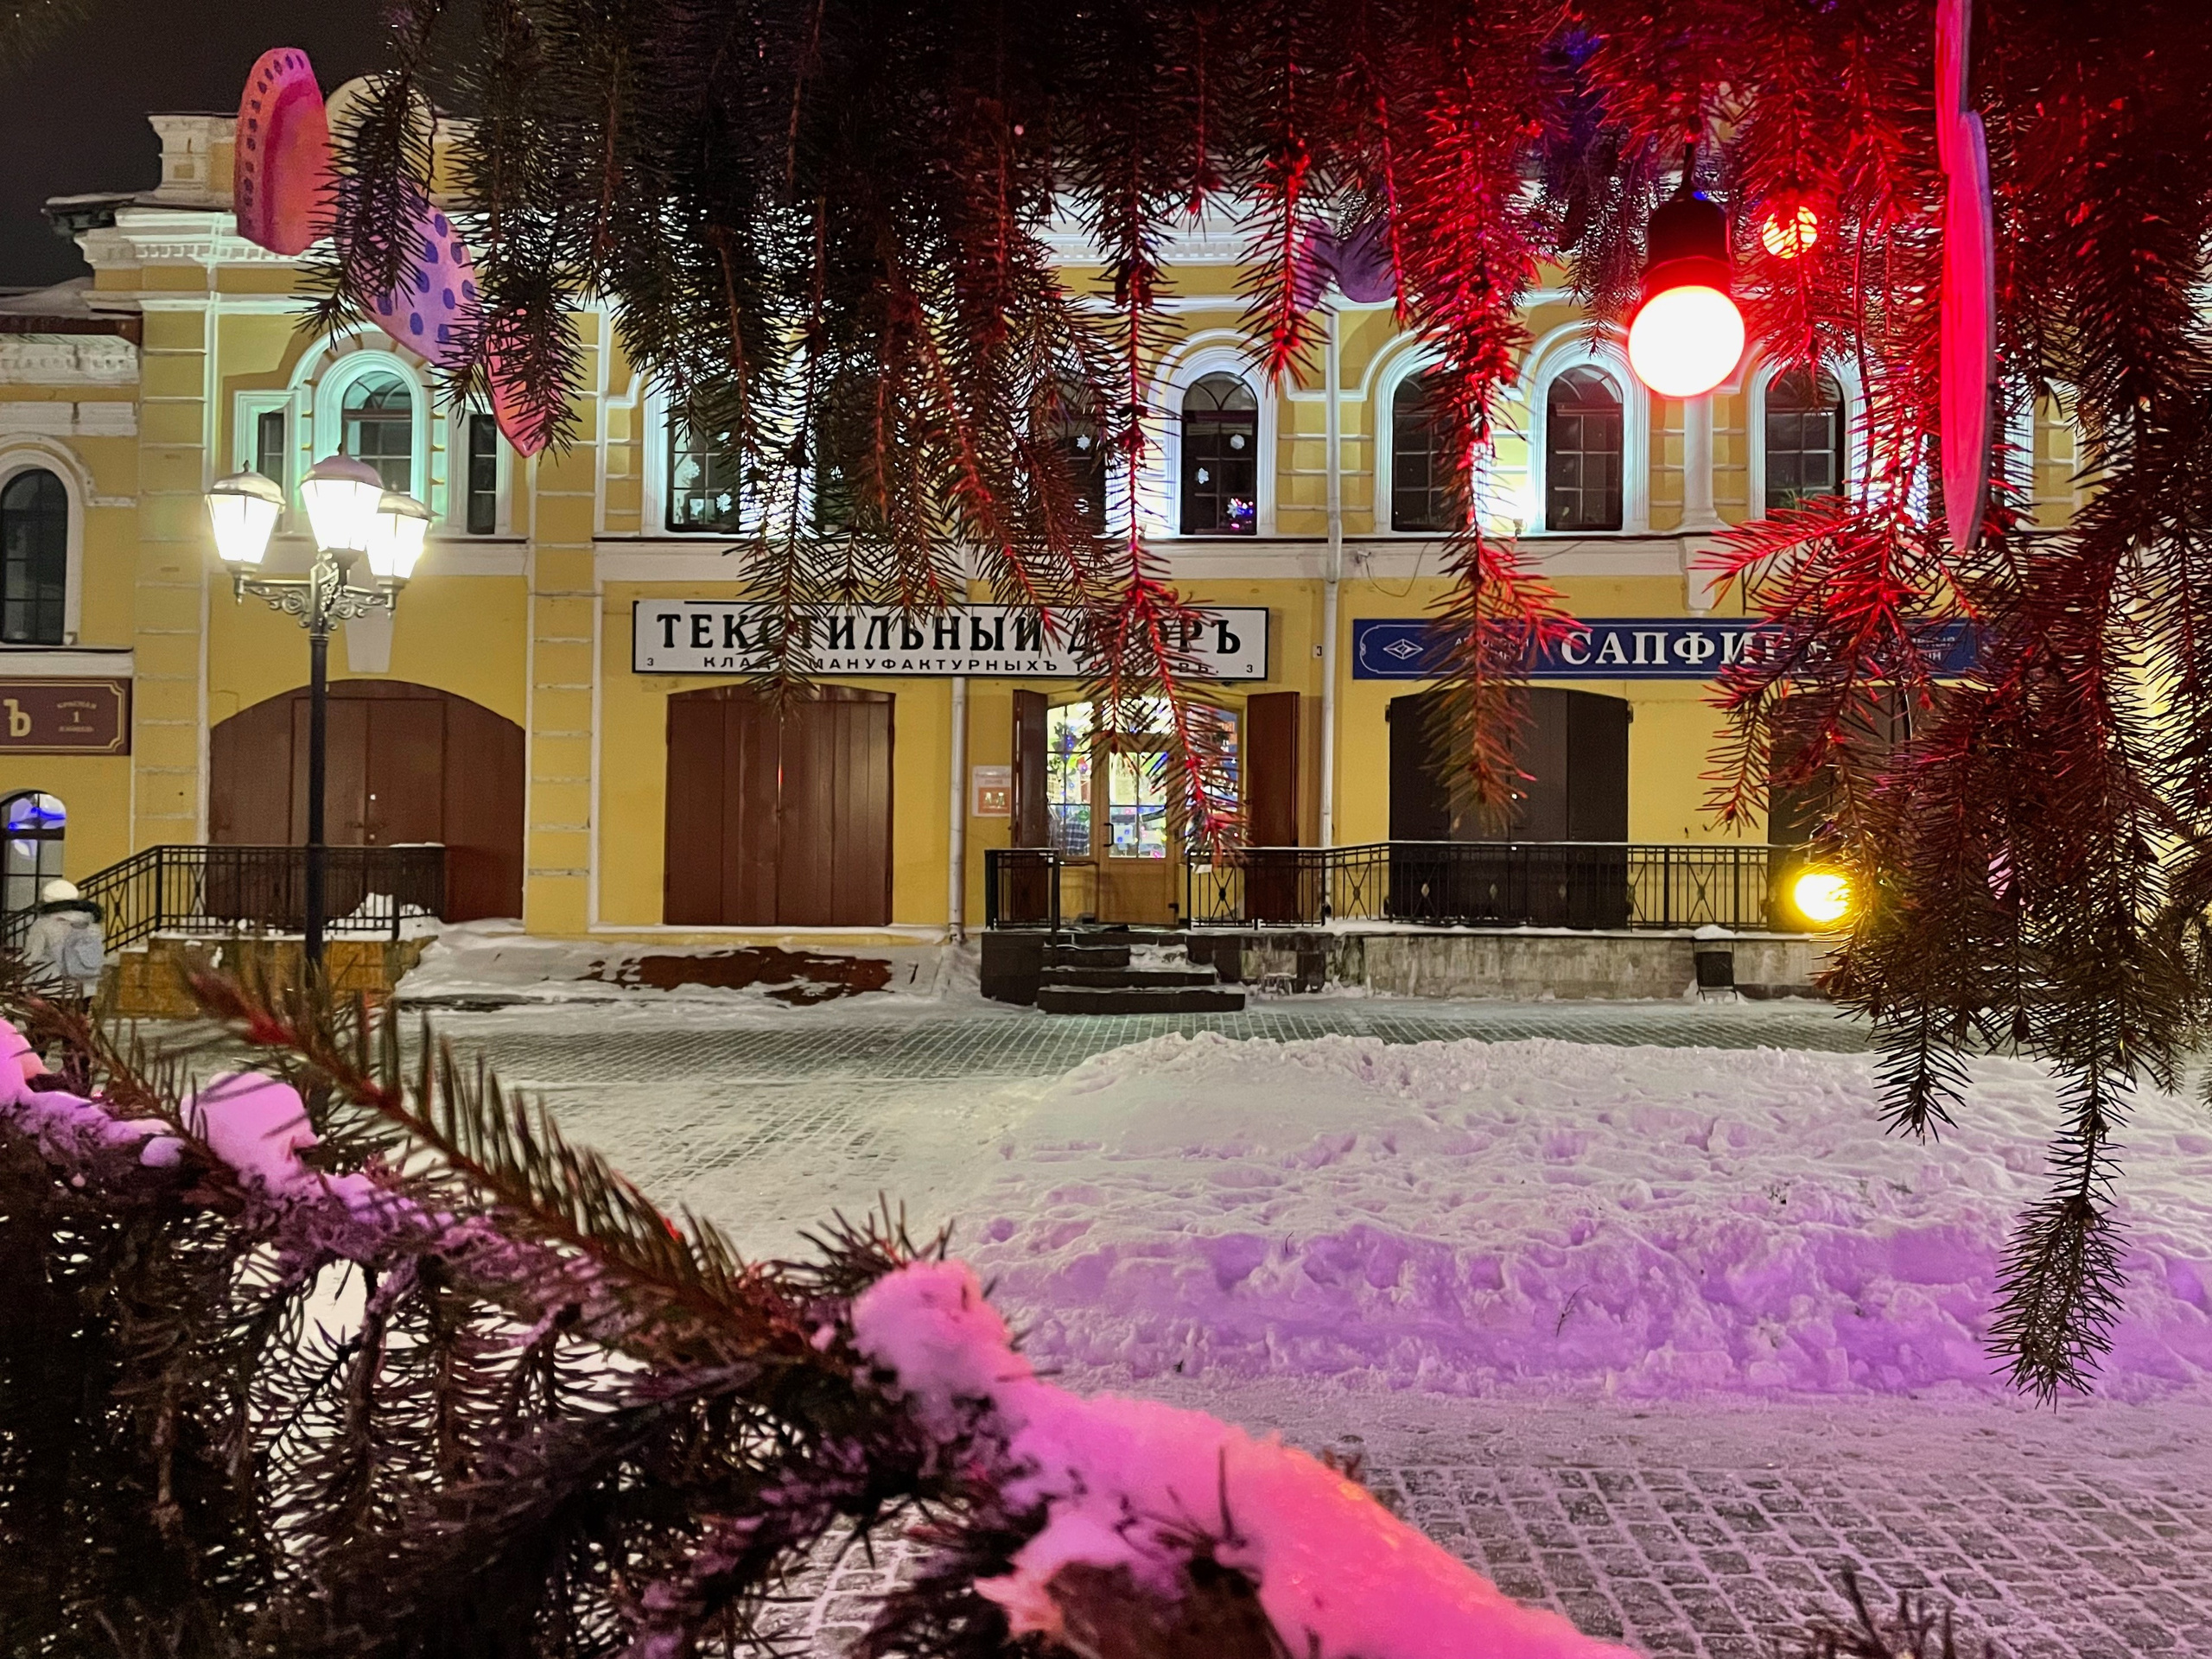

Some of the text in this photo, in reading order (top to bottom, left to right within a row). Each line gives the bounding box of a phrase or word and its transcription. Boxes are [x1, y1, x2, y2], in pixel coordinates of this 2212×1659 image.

[1067, 617, 1241, 655] ДОРЪ
[703, 657, 789, 671] КЛАД
[810, 658, 1057, 671] МАНУФАКТУРНЫХЪ
[73, 711, 79, 723] 1
